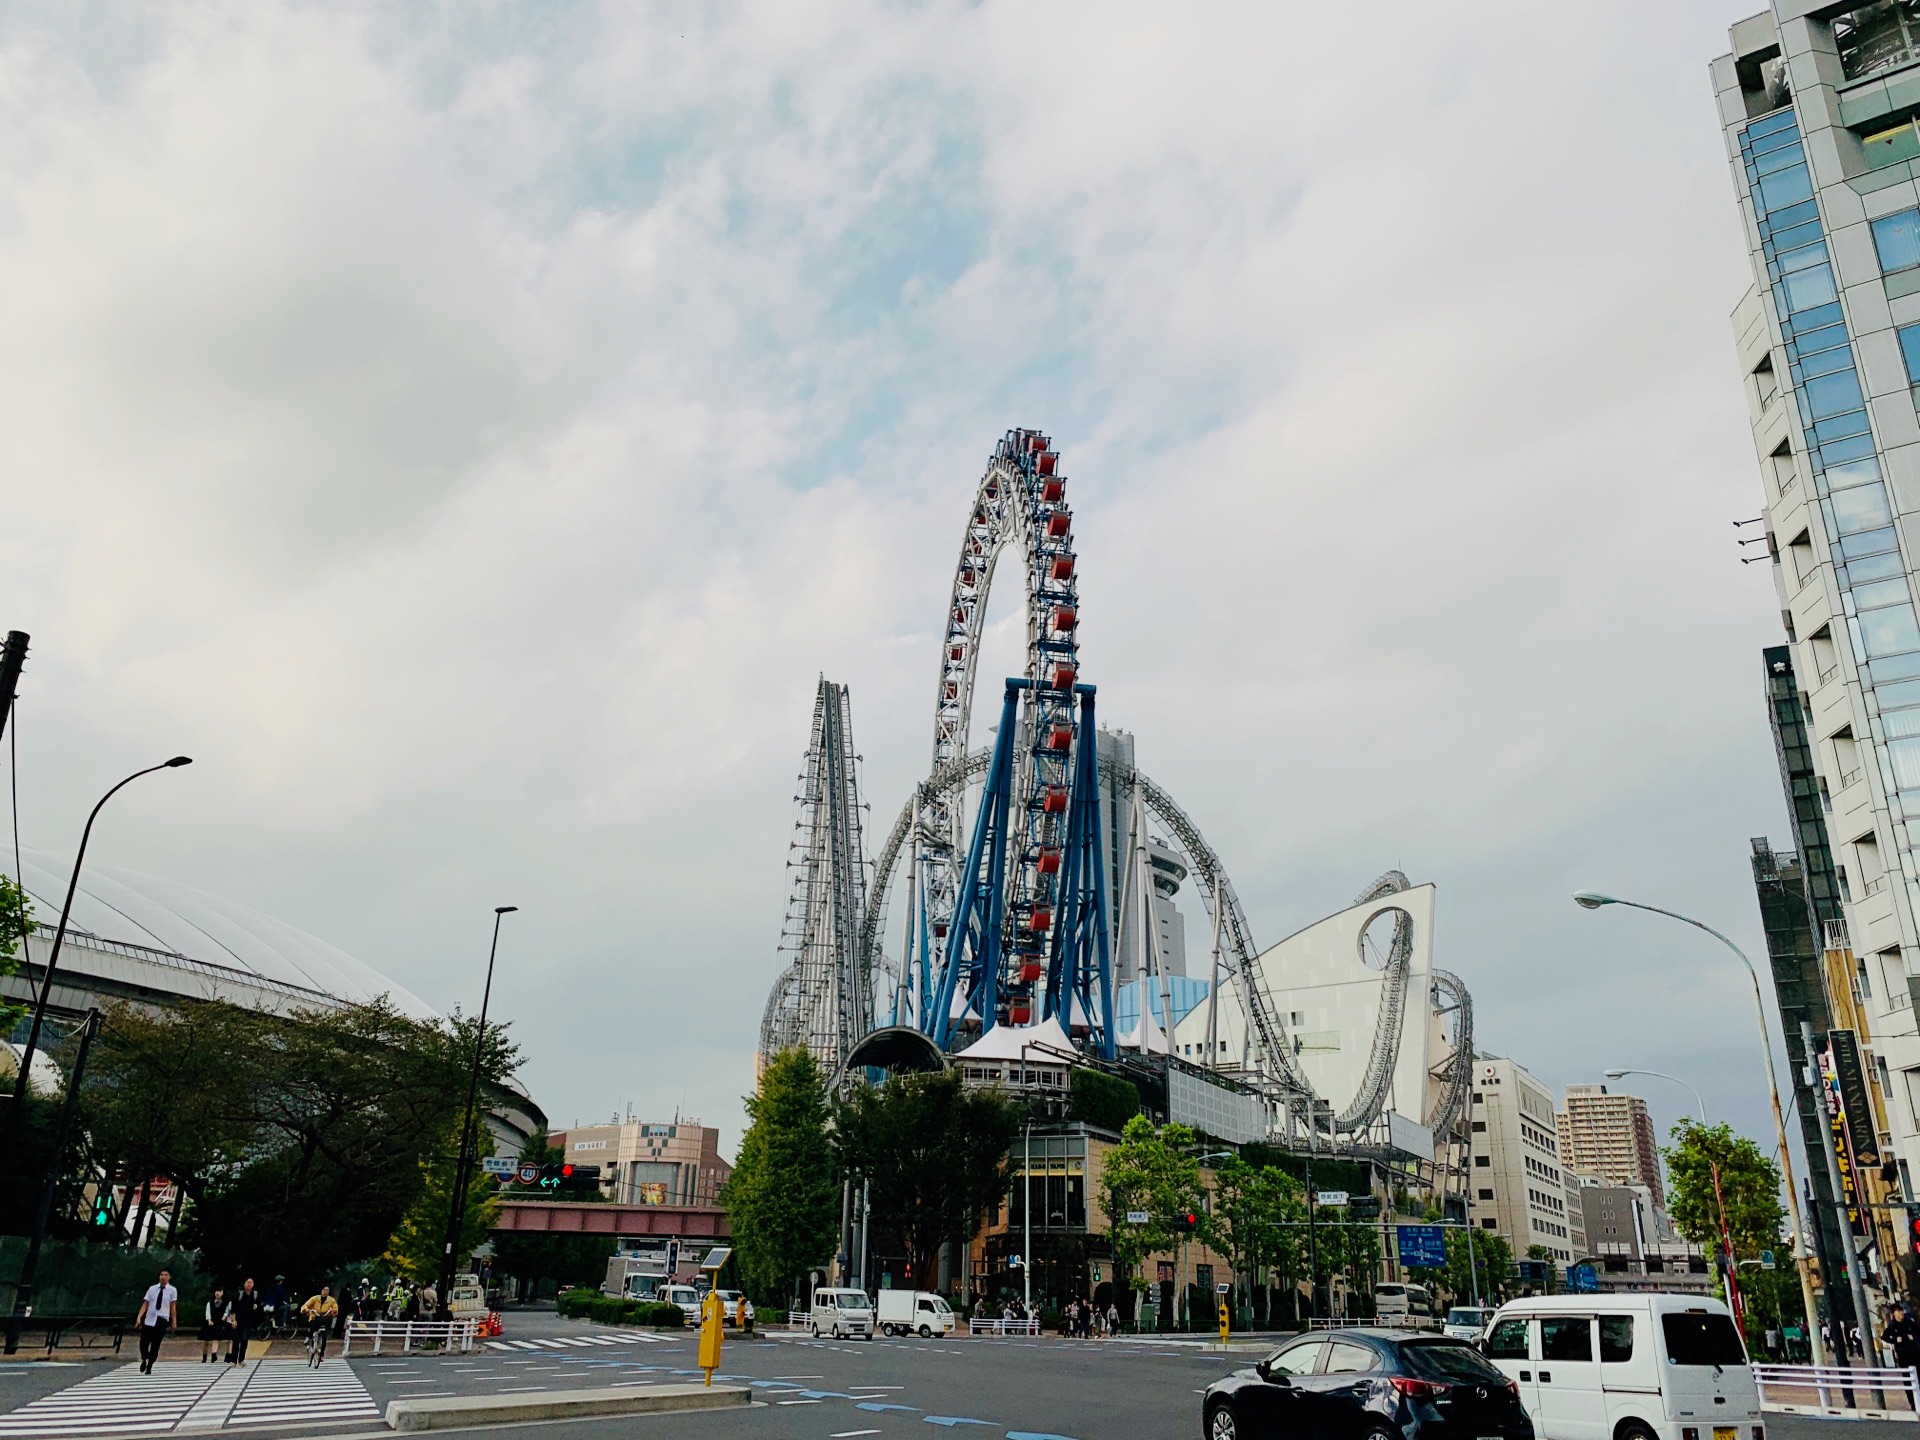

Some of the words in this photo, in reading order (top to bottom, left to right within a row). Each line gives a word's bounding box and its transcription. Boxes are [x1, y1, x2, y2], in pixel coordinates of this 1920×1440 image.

[1837, 1031, 1853, 1063] HOTEL
[1845, 1068, 1871, 1150] MANDARIN
[522, 1168, 534, 1178] 40
